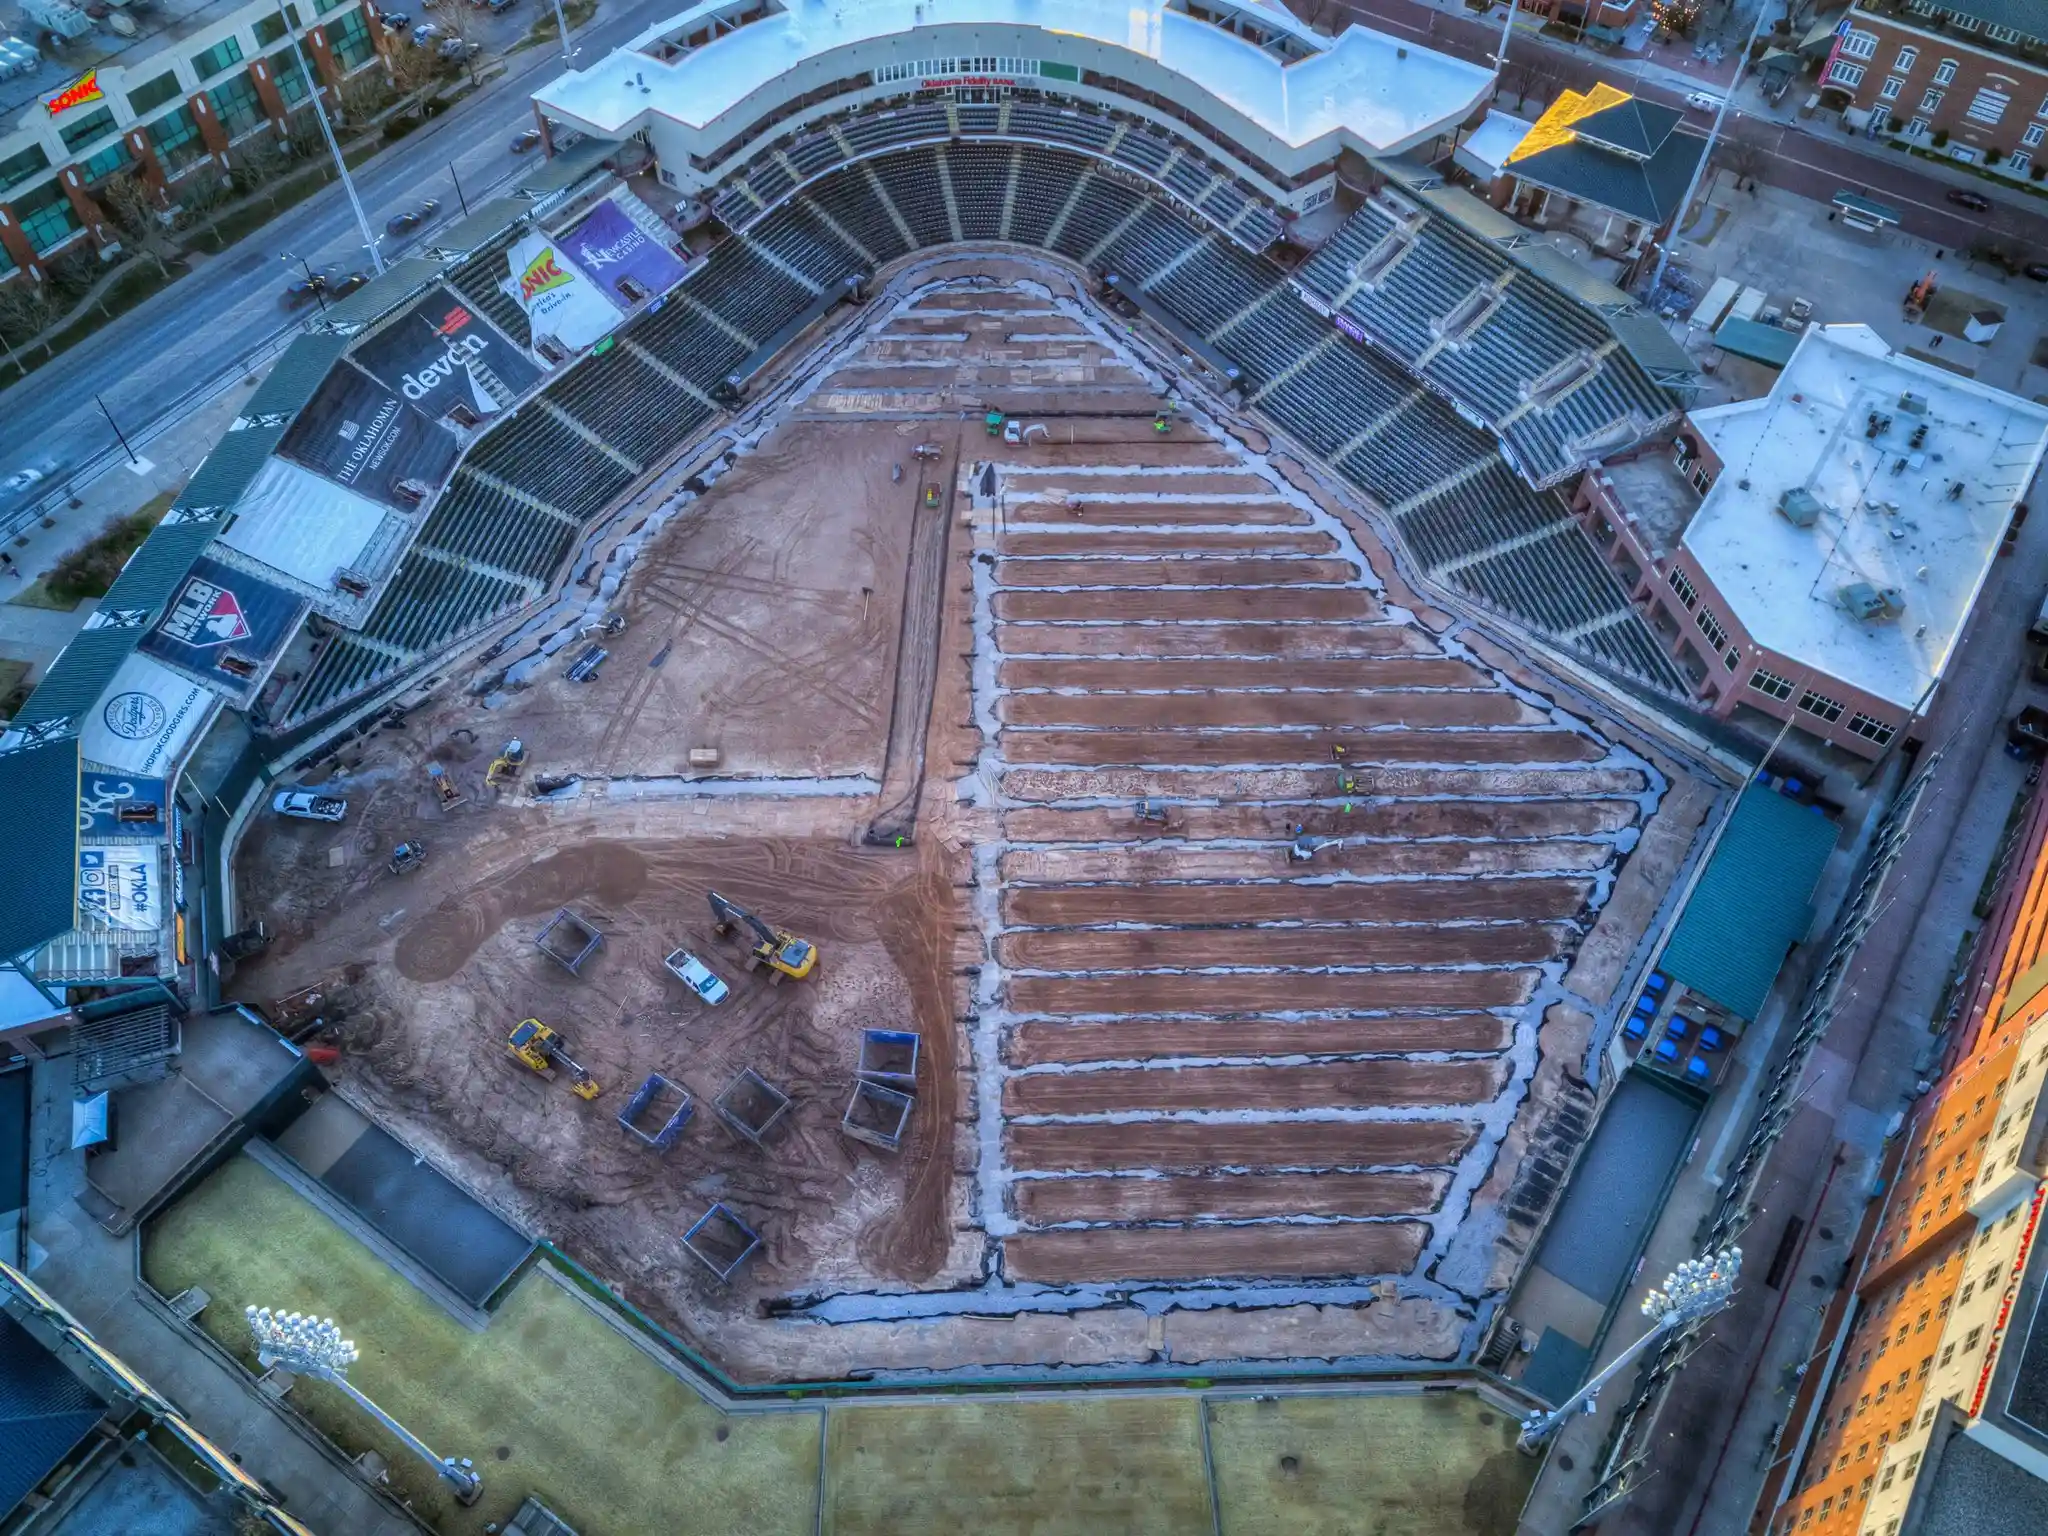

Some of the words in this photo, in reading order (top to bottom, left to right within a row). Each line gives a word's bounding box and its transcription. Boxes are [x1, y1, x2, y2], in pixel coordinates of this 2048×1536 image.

[49, 77, 99, 115] SONIC
[921, 79, 960, 88] Oklahoma
[963, 75, 990, 87] Fidelity
[992, 77, 1016, 86] BANK
[580, 228, 641, 270] NEWCASTLE
[616, 235, 645, 260] CASINO
[402, 333, 489, 400] devon
[336, 459, 357, 482] THE
[351, 397, 398, 463] OKLAHOMAN
[369, 426, 402, 471] NEWSOK.COM
[163, 581, 213, 638] MLB
[184, 589, 222, 641] NETWORK
[121, 695, 146, 737] Dodgers
[141, 687, 201, 774] SHOPOKCDODGERS.COM
[130, 863, 149, 913] #OKLA
